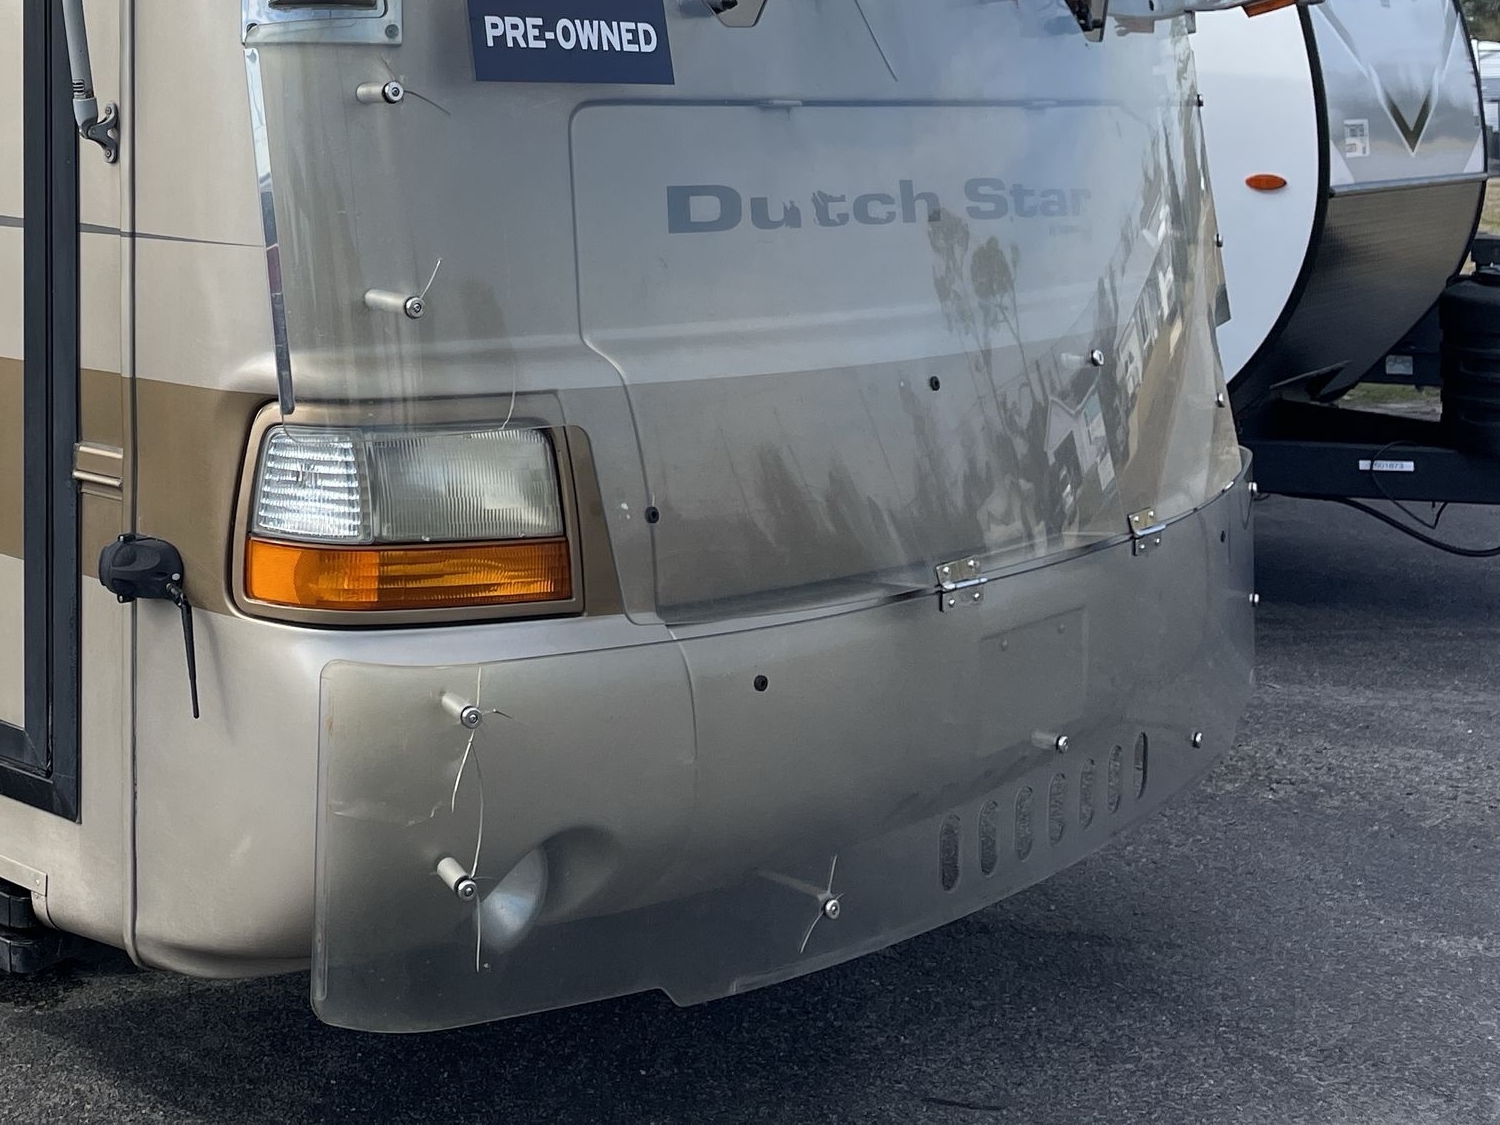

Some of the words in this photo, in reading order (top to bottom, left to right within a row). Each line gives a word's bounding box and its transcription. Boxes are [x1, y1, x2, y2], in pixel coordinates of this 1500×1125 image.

[484, 15, 658, 53] PRE-OWNED
[666, 179, 941, 234] Dutch
[964, 177, 1092, 221] Star
